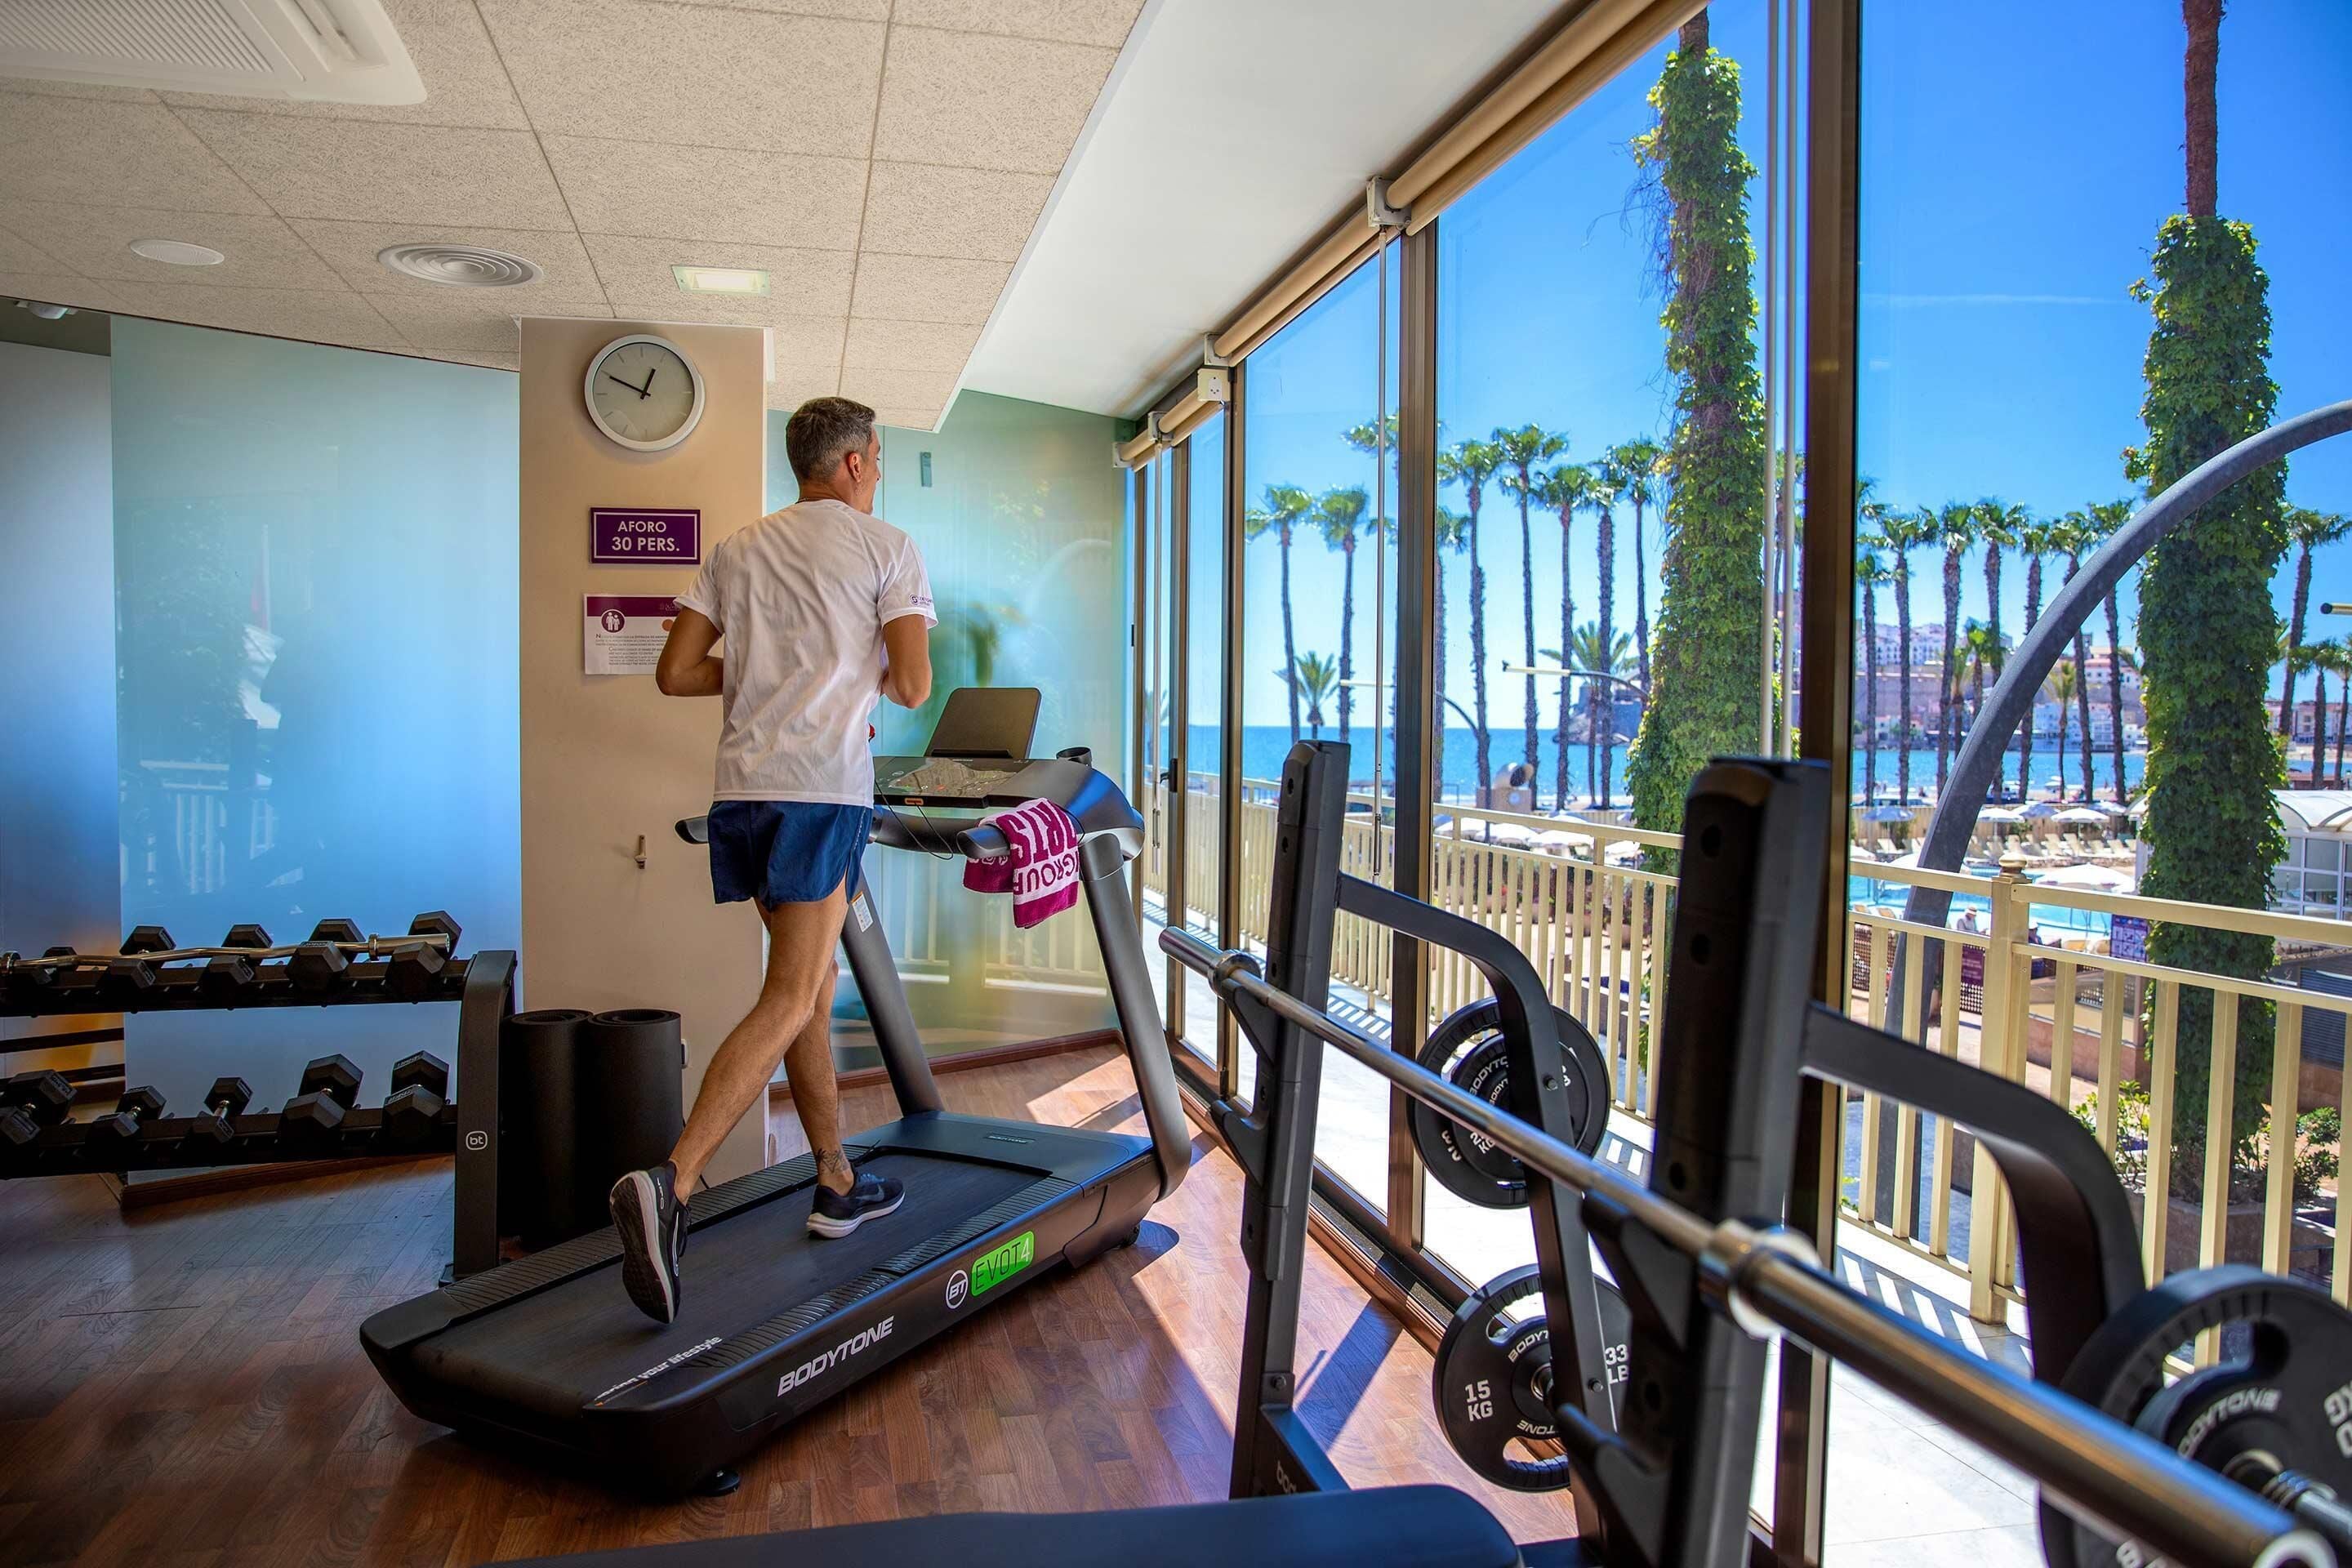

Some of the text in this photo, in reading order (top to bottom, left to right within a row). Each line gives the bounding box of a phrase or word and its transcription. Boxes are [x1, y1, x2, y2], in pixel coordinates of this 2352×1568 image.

[617, 521, 667, 532] AFORO
[612, 537, 680, 552] 30 PERS.
[976, 1237, 1031, 1290] EVOT4
[948, 1279, 968, 1300] BT
[636, 1361, 670, 1380] your
[666, 1336, 723, 1365] lifestyle
[777, 1316, 894, 1397] BODYTONE
[1606, 1344, 1629, 1365] 33
[1607, 1365, 1630, 1384] LB
[1464, 1379, 1491, 1403] 15
[1468, 1401, 1494, 1422] KG
